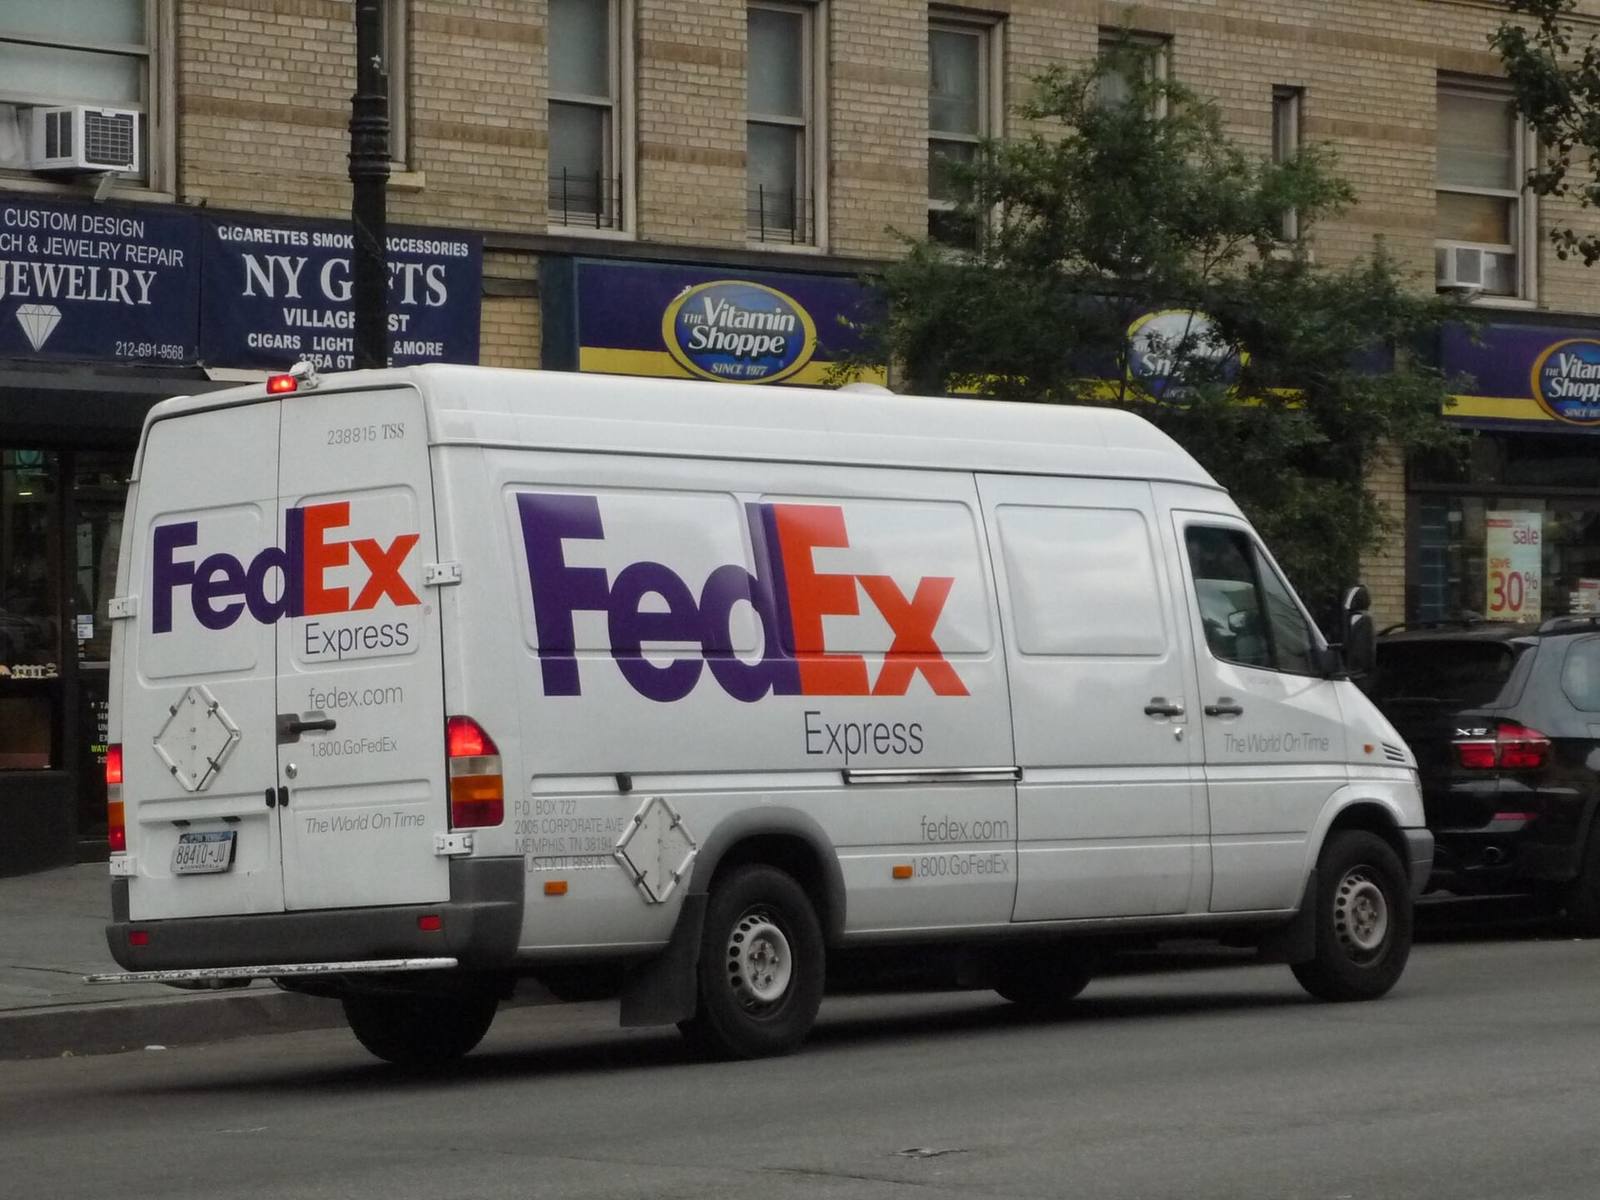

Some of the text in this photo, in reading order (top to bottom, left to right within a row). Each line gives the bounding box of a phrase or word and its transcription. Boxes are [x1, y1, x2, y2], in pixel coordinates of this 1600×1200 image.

[4, 208, 145, 239] CUSTOM DESIGN
[217, 226, 309, 246] CIGARETTES
[312, 232, 355, 249] SMOK
[27, 235, 39, 254] &
[43, 236, 122, 261] JEWELRY
[125, 244, 184, 267] REPAIR
[0, 260, 158, 305] JEWELRY
[241, 253, 448, 307] NY GTS
[703, 296, 796, 332] Vitamin
[115, 341, 184, 360] 212-691-9568
[247, 333, 302, 350] CIGARS
[313, 336, 354, 352] LIGHT
[688, 325, 786, 357] Shoppe
[336, 354, 355, 369] 6T
[711, 362, 743, 375] SINCE
[327, 422, 405, 445] 238815 TSS
[1512, 525, 1539, 545] sale
[152, 501, 422, 634] FedEx
[515, 492, 972, 703] FedEx
[305, 622, 410, 660] Express
[308, 685, 404, 710] fedex.com
[311, 736, 398, 758] 1.800.GoFedEx
[804, 711, 925, 766] Express
[1223, 731, 1329, 753] The World On Time
[535, 799, 557, 815] BOX
[559, 799, 577, 815] 727
[305, 811, 425, 834] The World On Time
[541, 817, 602, 834] CORPORATE
[920, 815, 1009, 841] fedex.com
[912, 853, 1009, 879] 1.800.GoFedEx
